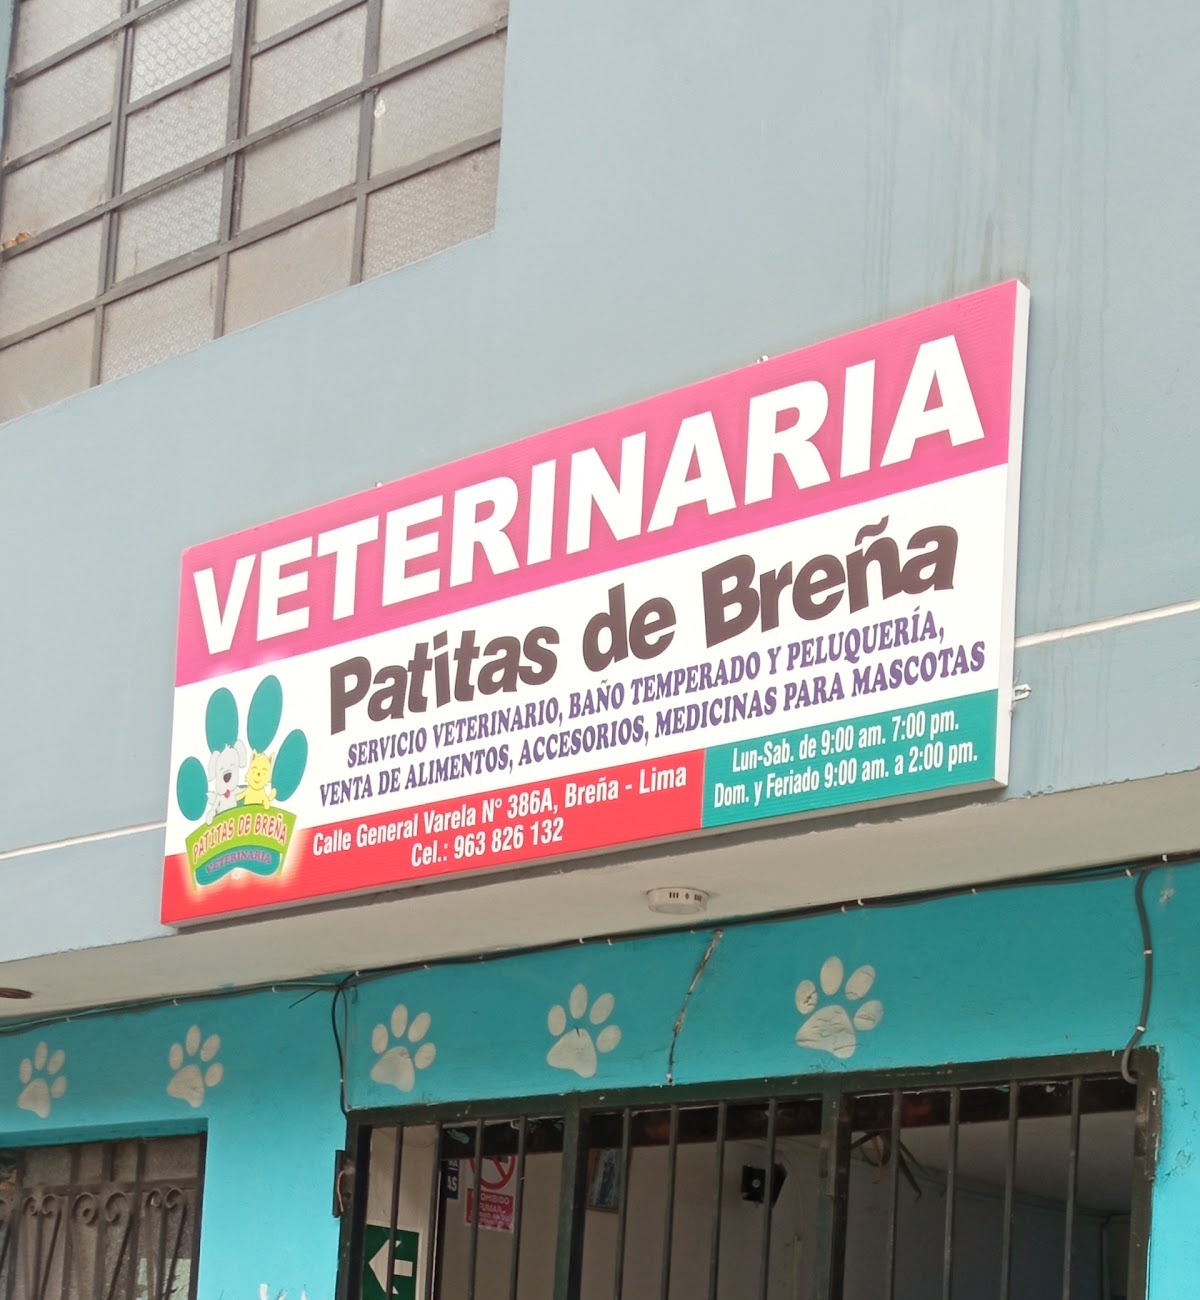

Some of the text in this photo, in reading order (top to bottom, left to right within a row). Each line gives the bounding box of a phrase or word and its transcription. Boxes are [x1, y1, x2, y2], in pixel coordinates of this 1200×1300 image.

[193, 335, 985, 656] VETERINARIA
[330, 515, 958, 736] Patitas de Breña
[320, 641, 986, 807] VENTA DE ALIMENTOS, ACCESORIOS, MEDICINAS PARA MASCOTAS
[347, 606, 945, 768] SERVICIO VETERINARIO, BAÑO TEMPERADO Y PELUQUERÍA,
[714, 741, 978, 808] Dom. y Feriado 9:00 am. a 2:00 pm.
[732, 710, 960, 773] Lun-Sab. de 9:00 am. 7:00 pm.
[193, 814, 287, 863] PATITAS DE BREÑA
[313, 829, 352, 856] Calle
[356, 814, 418, 848] General
[423, 804, 476, 837] Varela
[507, 787, 558, 819] 386A,
[564, 776, 619, 809] Breña
[639, 766, 687, 796] Lima
[411, 817, 564, 867] Cel.: 963 826 132
[206, 850, 272, 874] VETERINARIA
